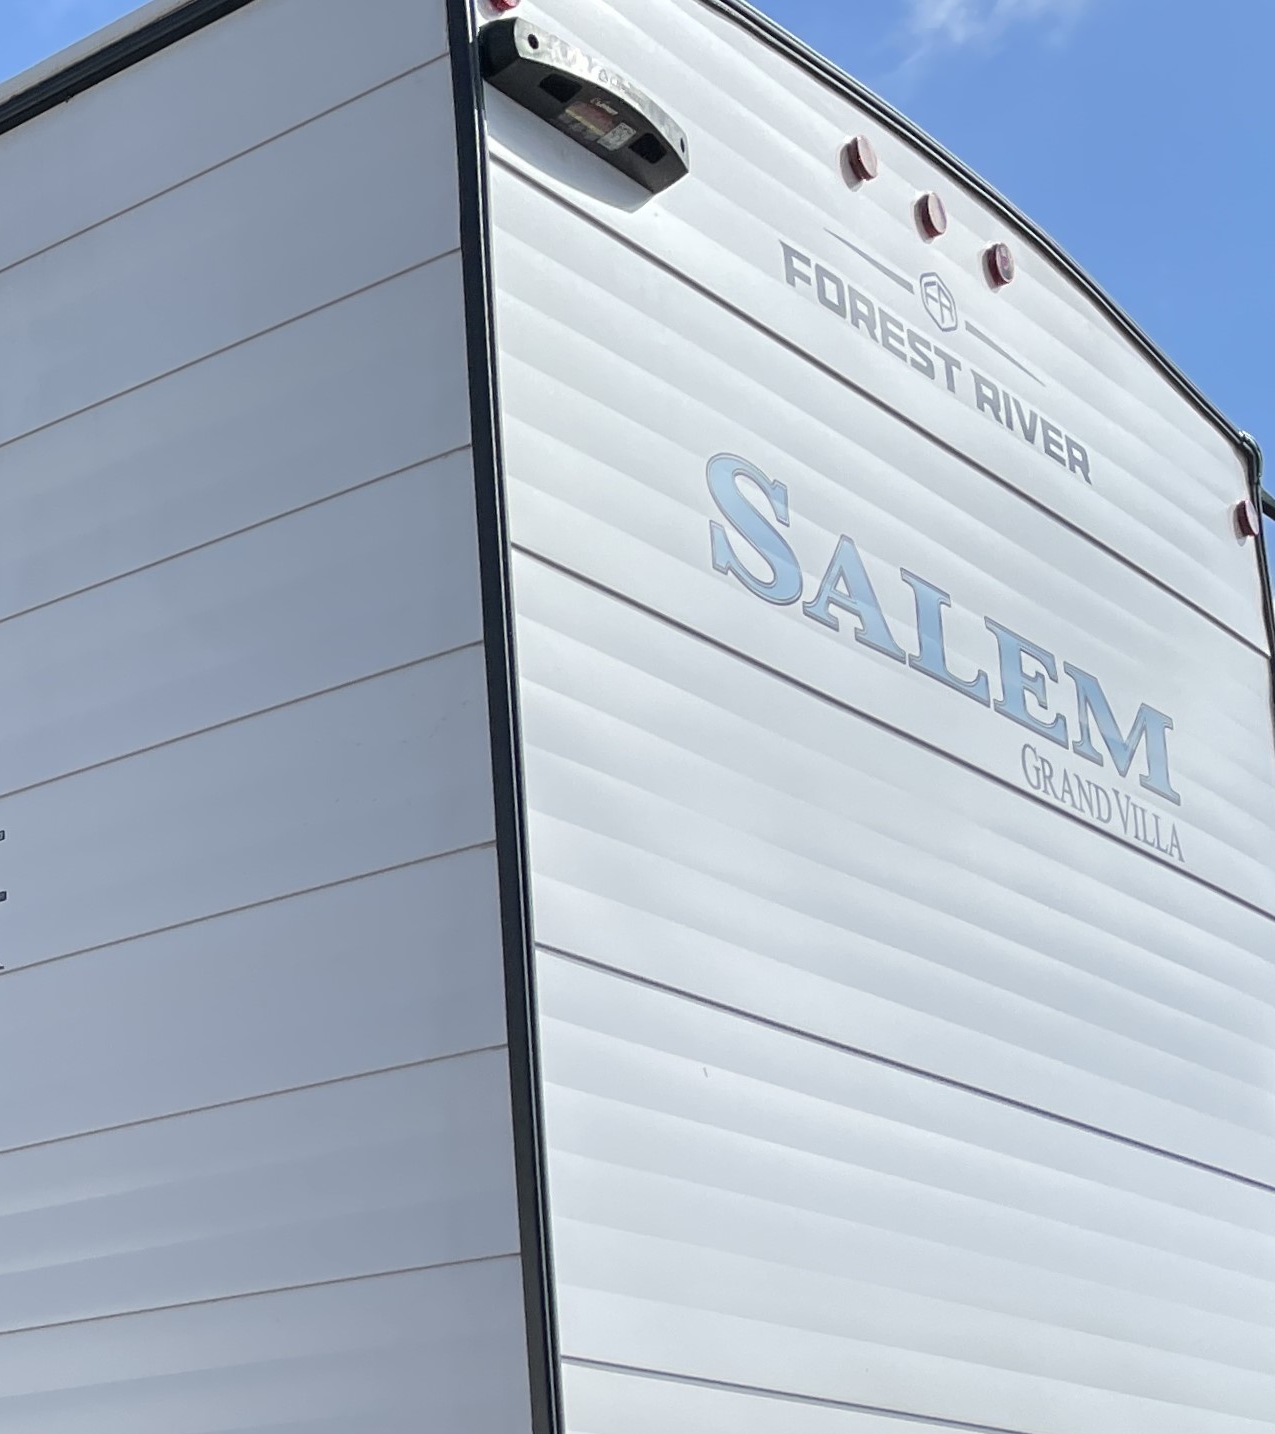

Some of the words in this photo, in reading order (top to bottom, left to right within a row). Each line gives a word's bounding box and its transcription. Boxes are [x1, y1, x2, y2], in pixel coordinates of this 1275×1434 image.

[779, 239, 962, 394] FOREST
[970, 368, 1092, 485] RIVER
[706, 452, 1181, 807] SALEM
[1020, 743, 1113, 826] GRAND
[1112, 787, 1186, 863] VILLA
